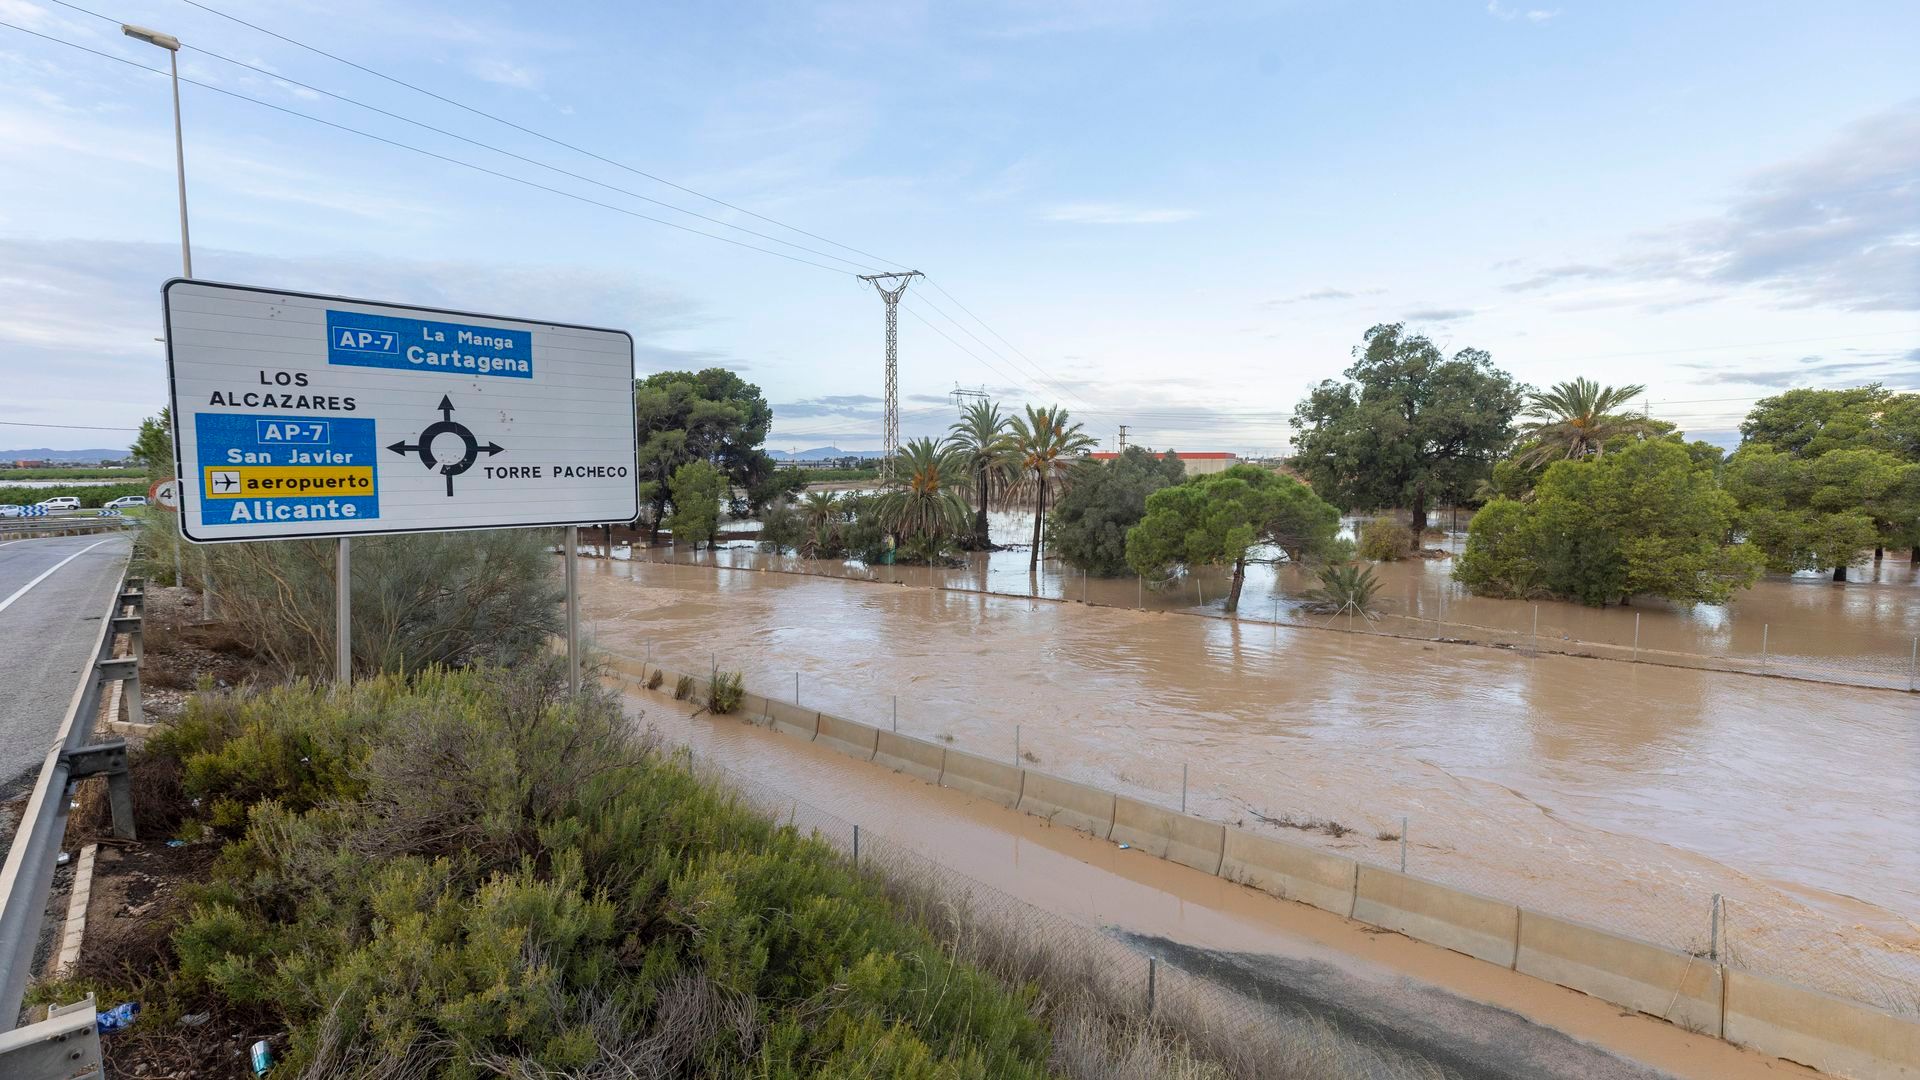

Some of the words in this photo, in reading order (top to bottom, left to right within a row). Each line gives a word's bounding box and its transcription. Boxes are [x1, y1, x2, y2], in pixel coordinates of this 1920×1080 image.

[340, 331, 393, 350] AP-7
[423, 327, 445, 342] La
[458, 331, 514, 350] Manga
[407, 346, 529, 372] Cartagena
[260, 371, 309, 387] LOS
[209, 391, 356, 411] ALCAZARES
[264, 424, 323, 441] AP-7
[227, 448, 271, 464] San
[288, 449, 353, 464] Javier
[484, 466, 542, 479] TORRE
[553, 466, 627, 478] PACHECO
[247, 475, 369, 491] aeropuerto
[160, 488, 177, 499] 4
[230, 500, 356, 521] Alicante
